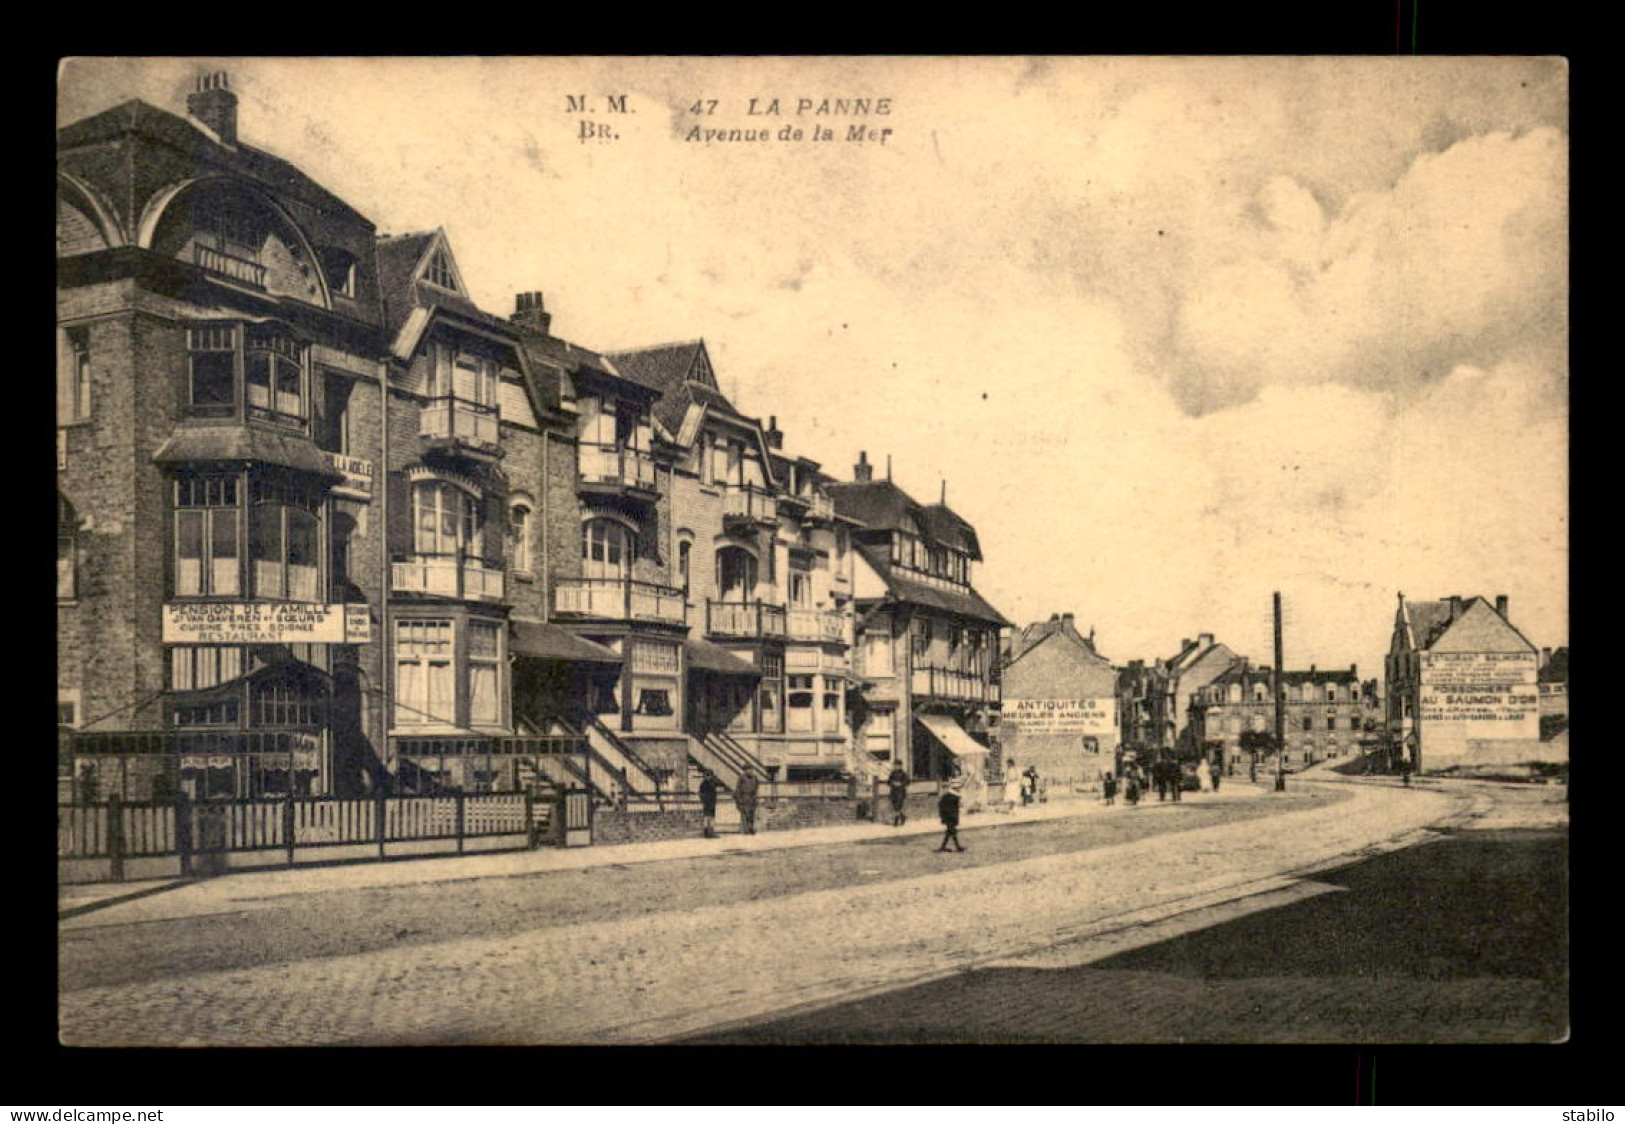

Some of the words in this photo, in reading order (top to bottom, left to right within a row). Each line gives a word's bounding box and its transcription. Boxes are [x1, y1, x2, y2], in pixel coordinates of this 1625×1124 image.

[169, 604, 235, 615] PENSION
[244, 604, 260, 615] DE
[270, 604, 332, 615] FAMILLE
[180, 623, 222, 632] CUISINE
[198, 632, 283, 642] RESTAURANT
[1422, 695, 1438, 704] AU
[1446, 695, 1502, 704] SAUMON
[1003, 711, 1055, 719] MEUBLES
[1059, 711, 1106, 719] ANCIENS
